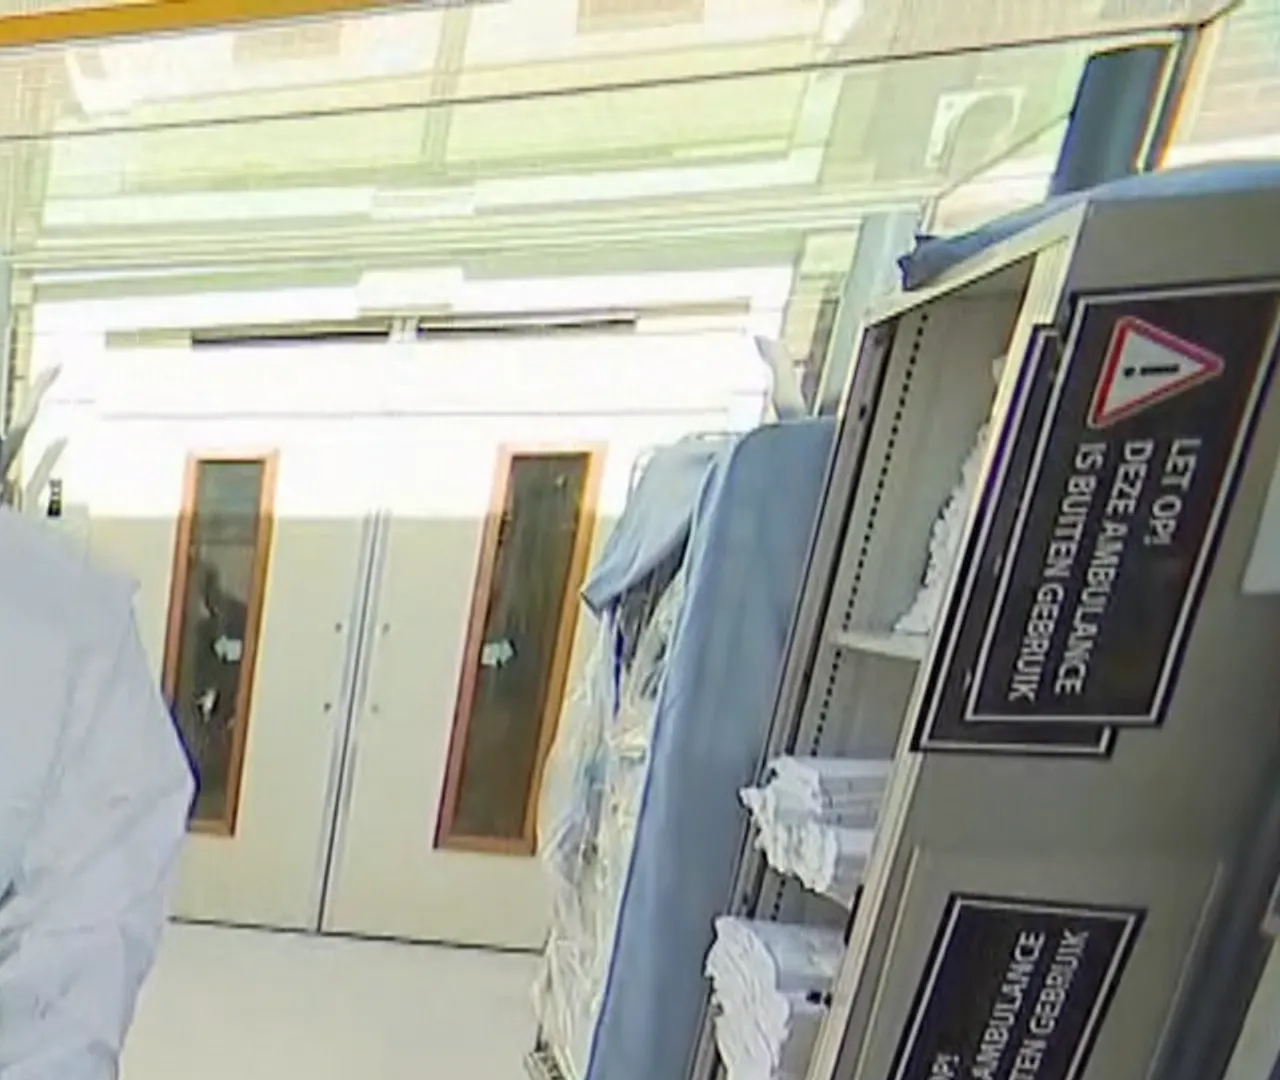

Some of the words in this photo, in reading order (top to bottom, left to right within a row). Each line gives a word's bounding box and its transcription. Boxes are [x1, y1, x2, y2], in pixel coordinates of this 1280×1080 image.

[1074, 441, 1107, 472] IS
[1106, 440, 1153, 516] DEZE
[1161, 439, 1201, 490] LET
[1044, 475, 1097, 578] BUITEN
[1144, 496, 1181, 545] OP!
[1008, 583, 1064, 702] GEBRUIK
[1054, 520, 1127, 695] AMBULANCE
[1029, 927, 1090, 1035] GEBRUIK
